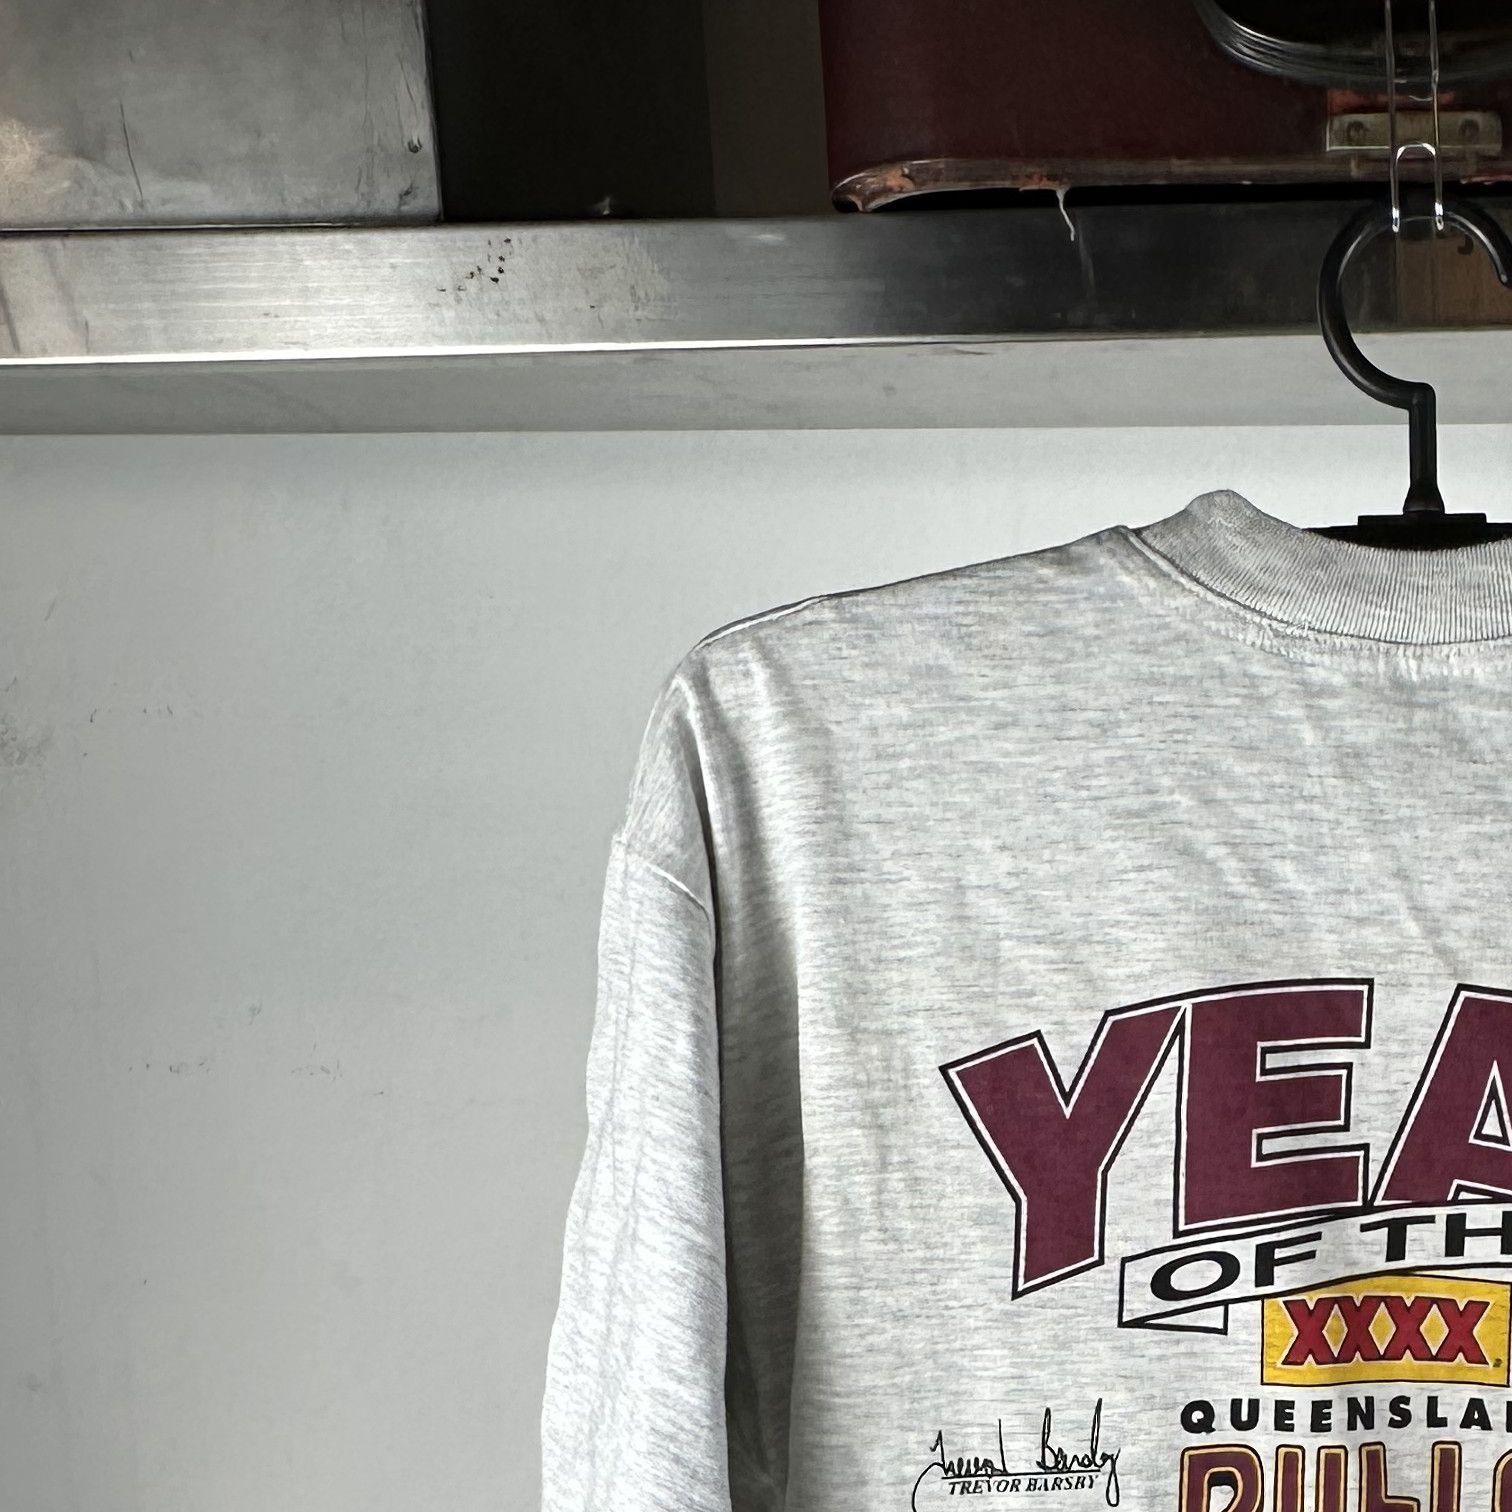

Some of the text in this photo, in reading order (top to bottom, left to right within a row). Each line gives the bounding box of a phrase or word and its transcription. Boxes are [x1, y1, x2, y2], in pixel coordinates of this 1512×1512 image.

[1149, 1237, 1320, 1303] OF
[1281, 1295, 1490, 1366] XXXX
[949, 1475, 1101, 1496] TREVOR BARSBY
